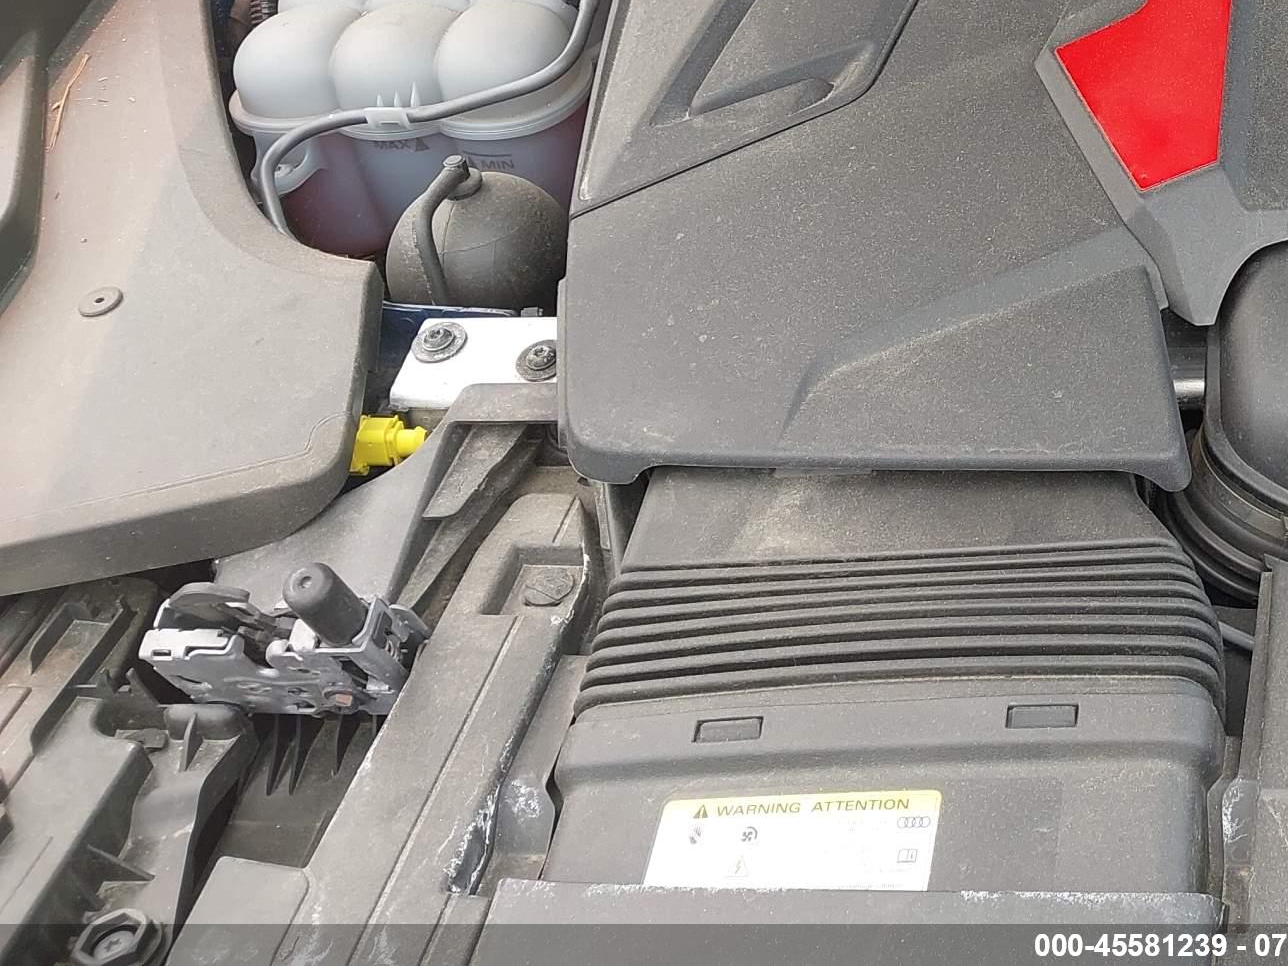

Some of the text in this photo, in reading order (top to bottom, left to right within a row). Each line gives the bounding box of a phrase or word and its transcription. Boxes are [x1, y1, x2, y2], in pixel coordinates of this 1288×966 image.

[373, 139, 411, 150] MAX
[481, 159, 515, 170] MIN
[716, 798, 911, 818] WARNING ATTENTION
